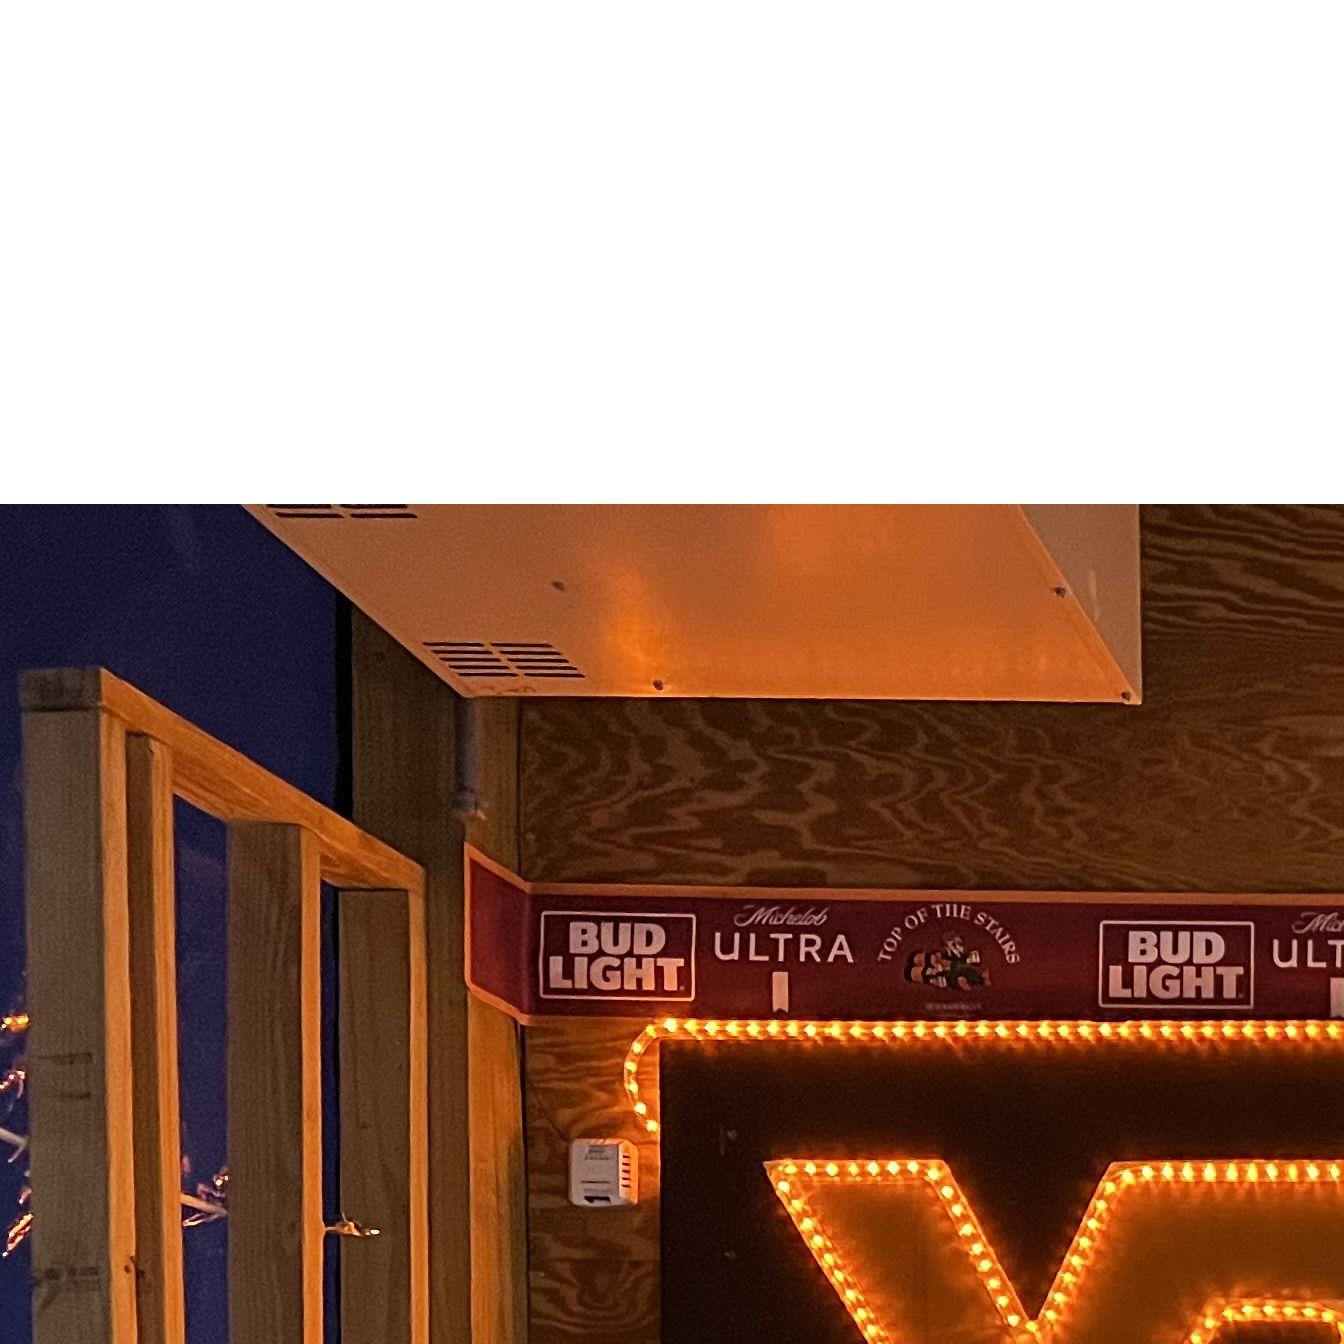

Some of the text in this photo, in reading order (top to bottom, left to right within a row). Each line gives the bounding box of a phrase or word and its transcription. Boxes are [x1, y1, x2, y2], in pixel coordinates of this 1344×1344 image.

[733, 904, 830, 927] Michelob
[569, 921, 666, 955] BUD
[714, 931, 855, 963] ULTRA
[877, 903, 1021, 964] TOP OF THE STAIRS
[1127, 930, 1226, 964] BUD
[549, 955, 686, 991] LIGHT
[1108, 965, 1245, 999] LIGHT
